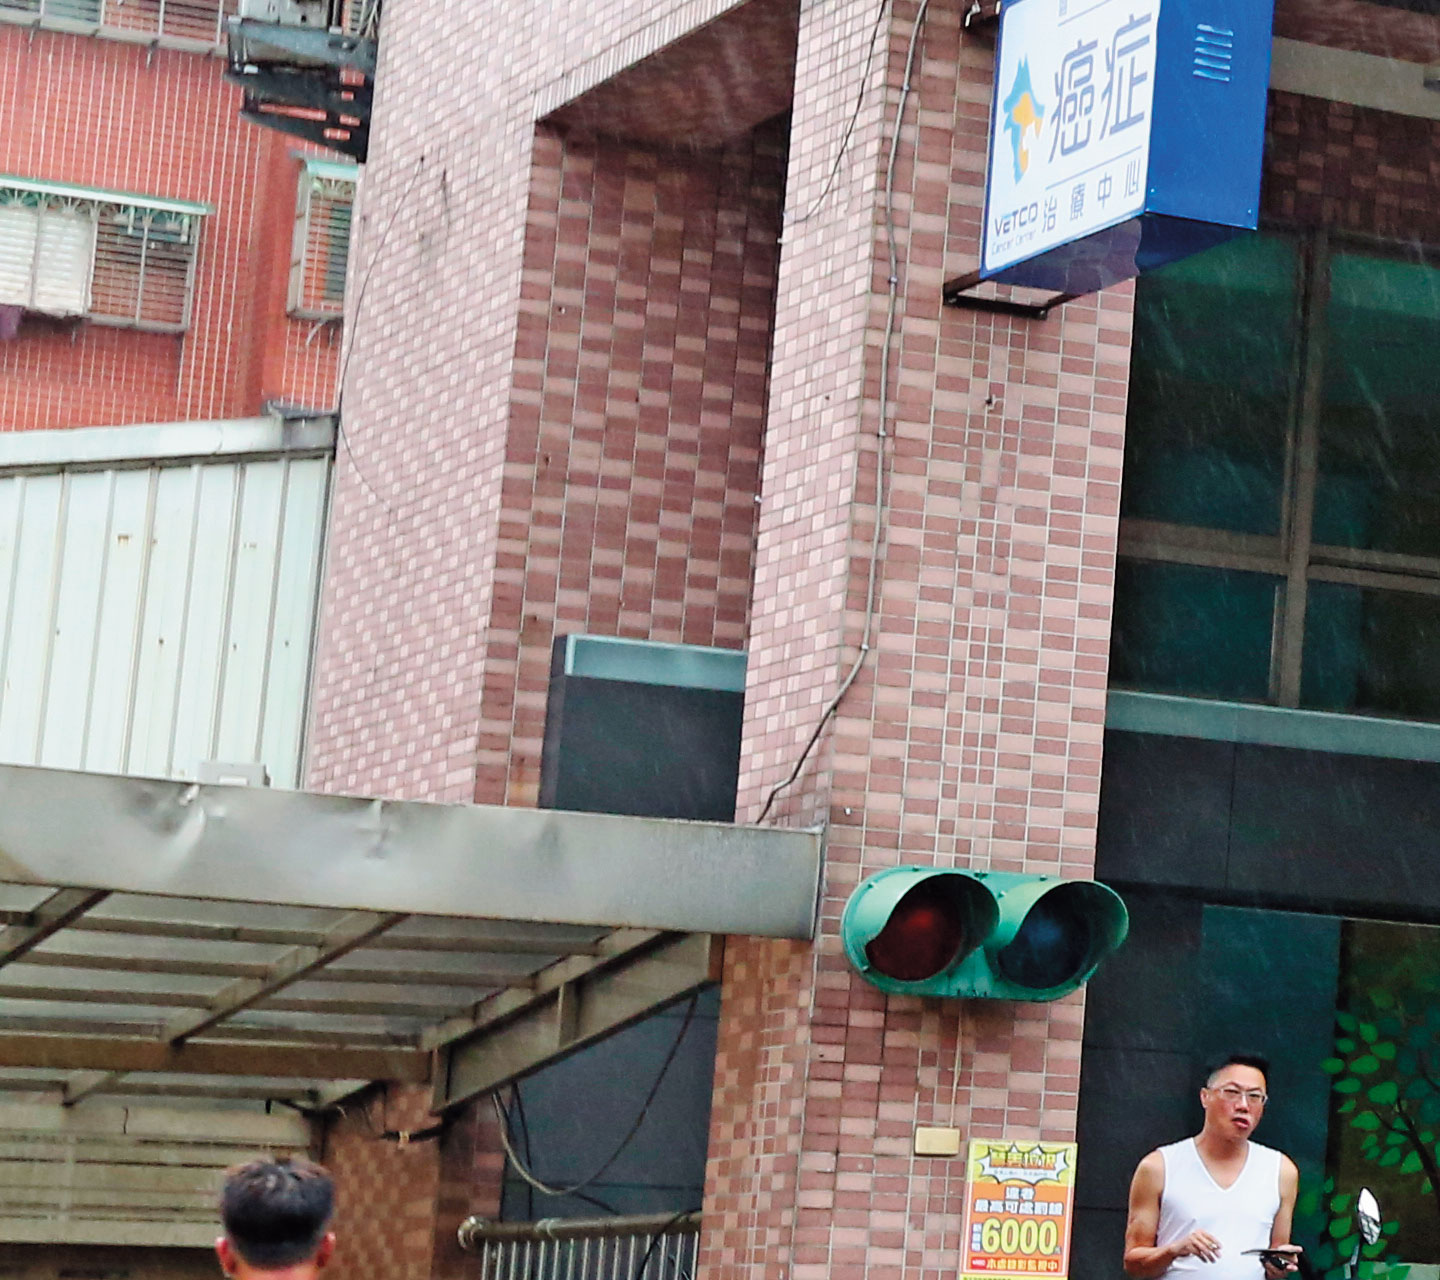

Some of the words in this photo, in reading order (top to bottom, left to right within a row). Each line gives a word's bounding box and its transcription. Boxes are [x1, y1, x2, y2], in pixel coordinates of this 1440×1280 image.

[1048, 12, 1152, 164] 癌症
[1042, 158, 1141, 233] 治療中心
[981, 1217, 1058, 1256] 6000
